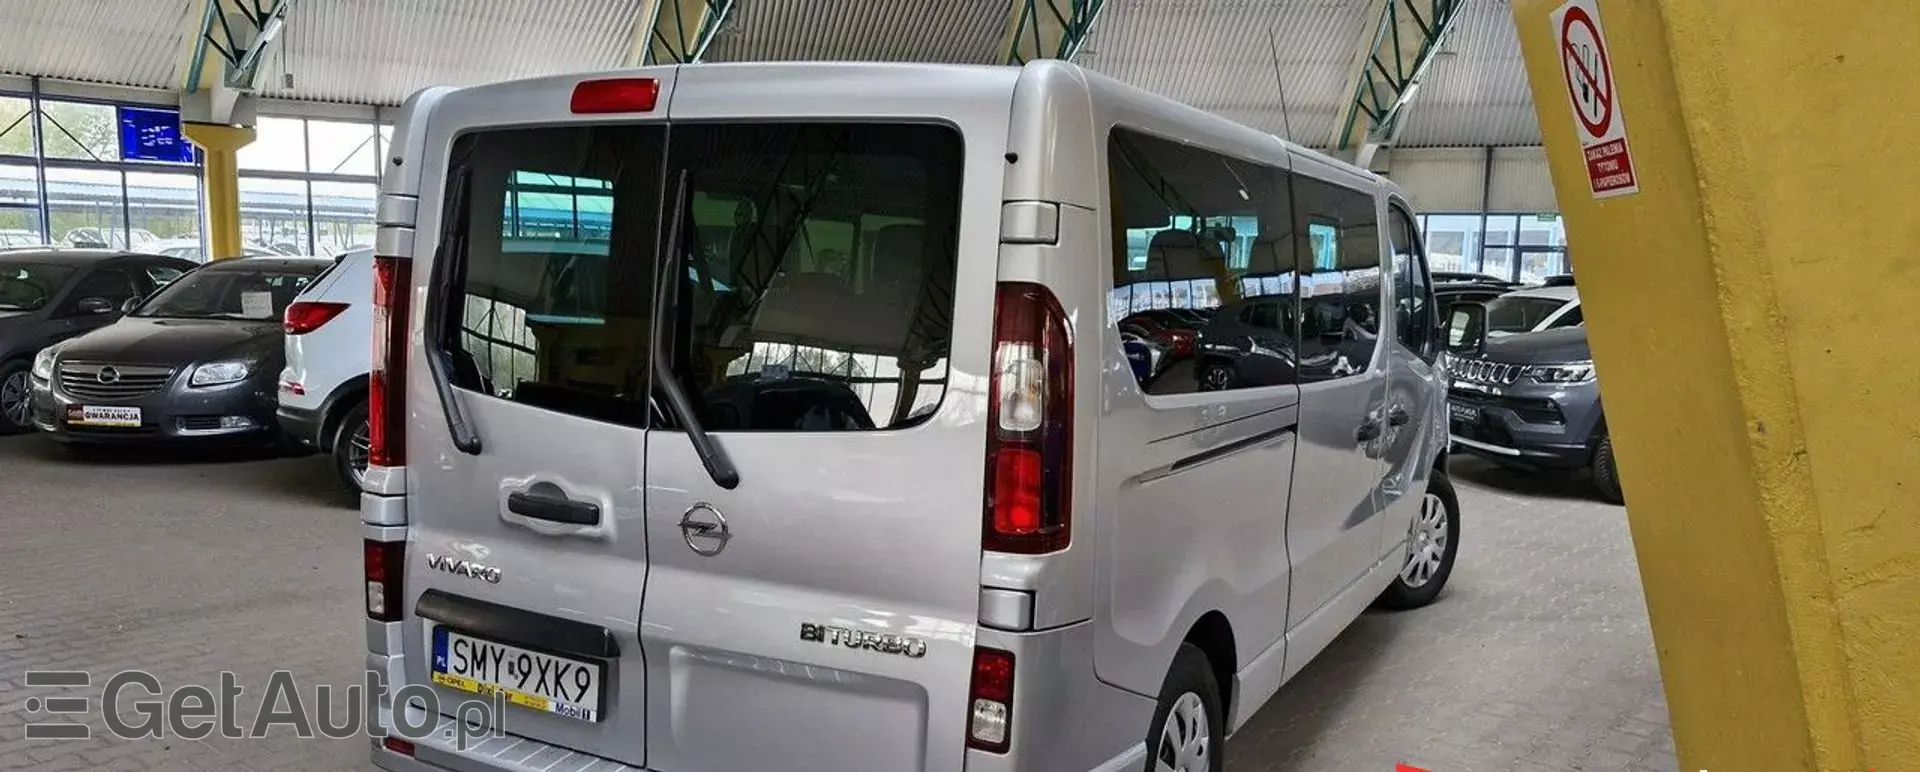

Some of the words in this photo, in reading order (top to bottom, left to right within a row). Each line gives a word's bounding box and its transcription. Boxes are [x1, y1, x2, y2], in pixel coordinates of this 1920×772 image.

[84, 412, 140, 421] GWARANCJA
[425, 553, 502, 584] VIVARO
[453, 638, 505, 684] SMY
[517, 653, 591, 703] 9XK9
